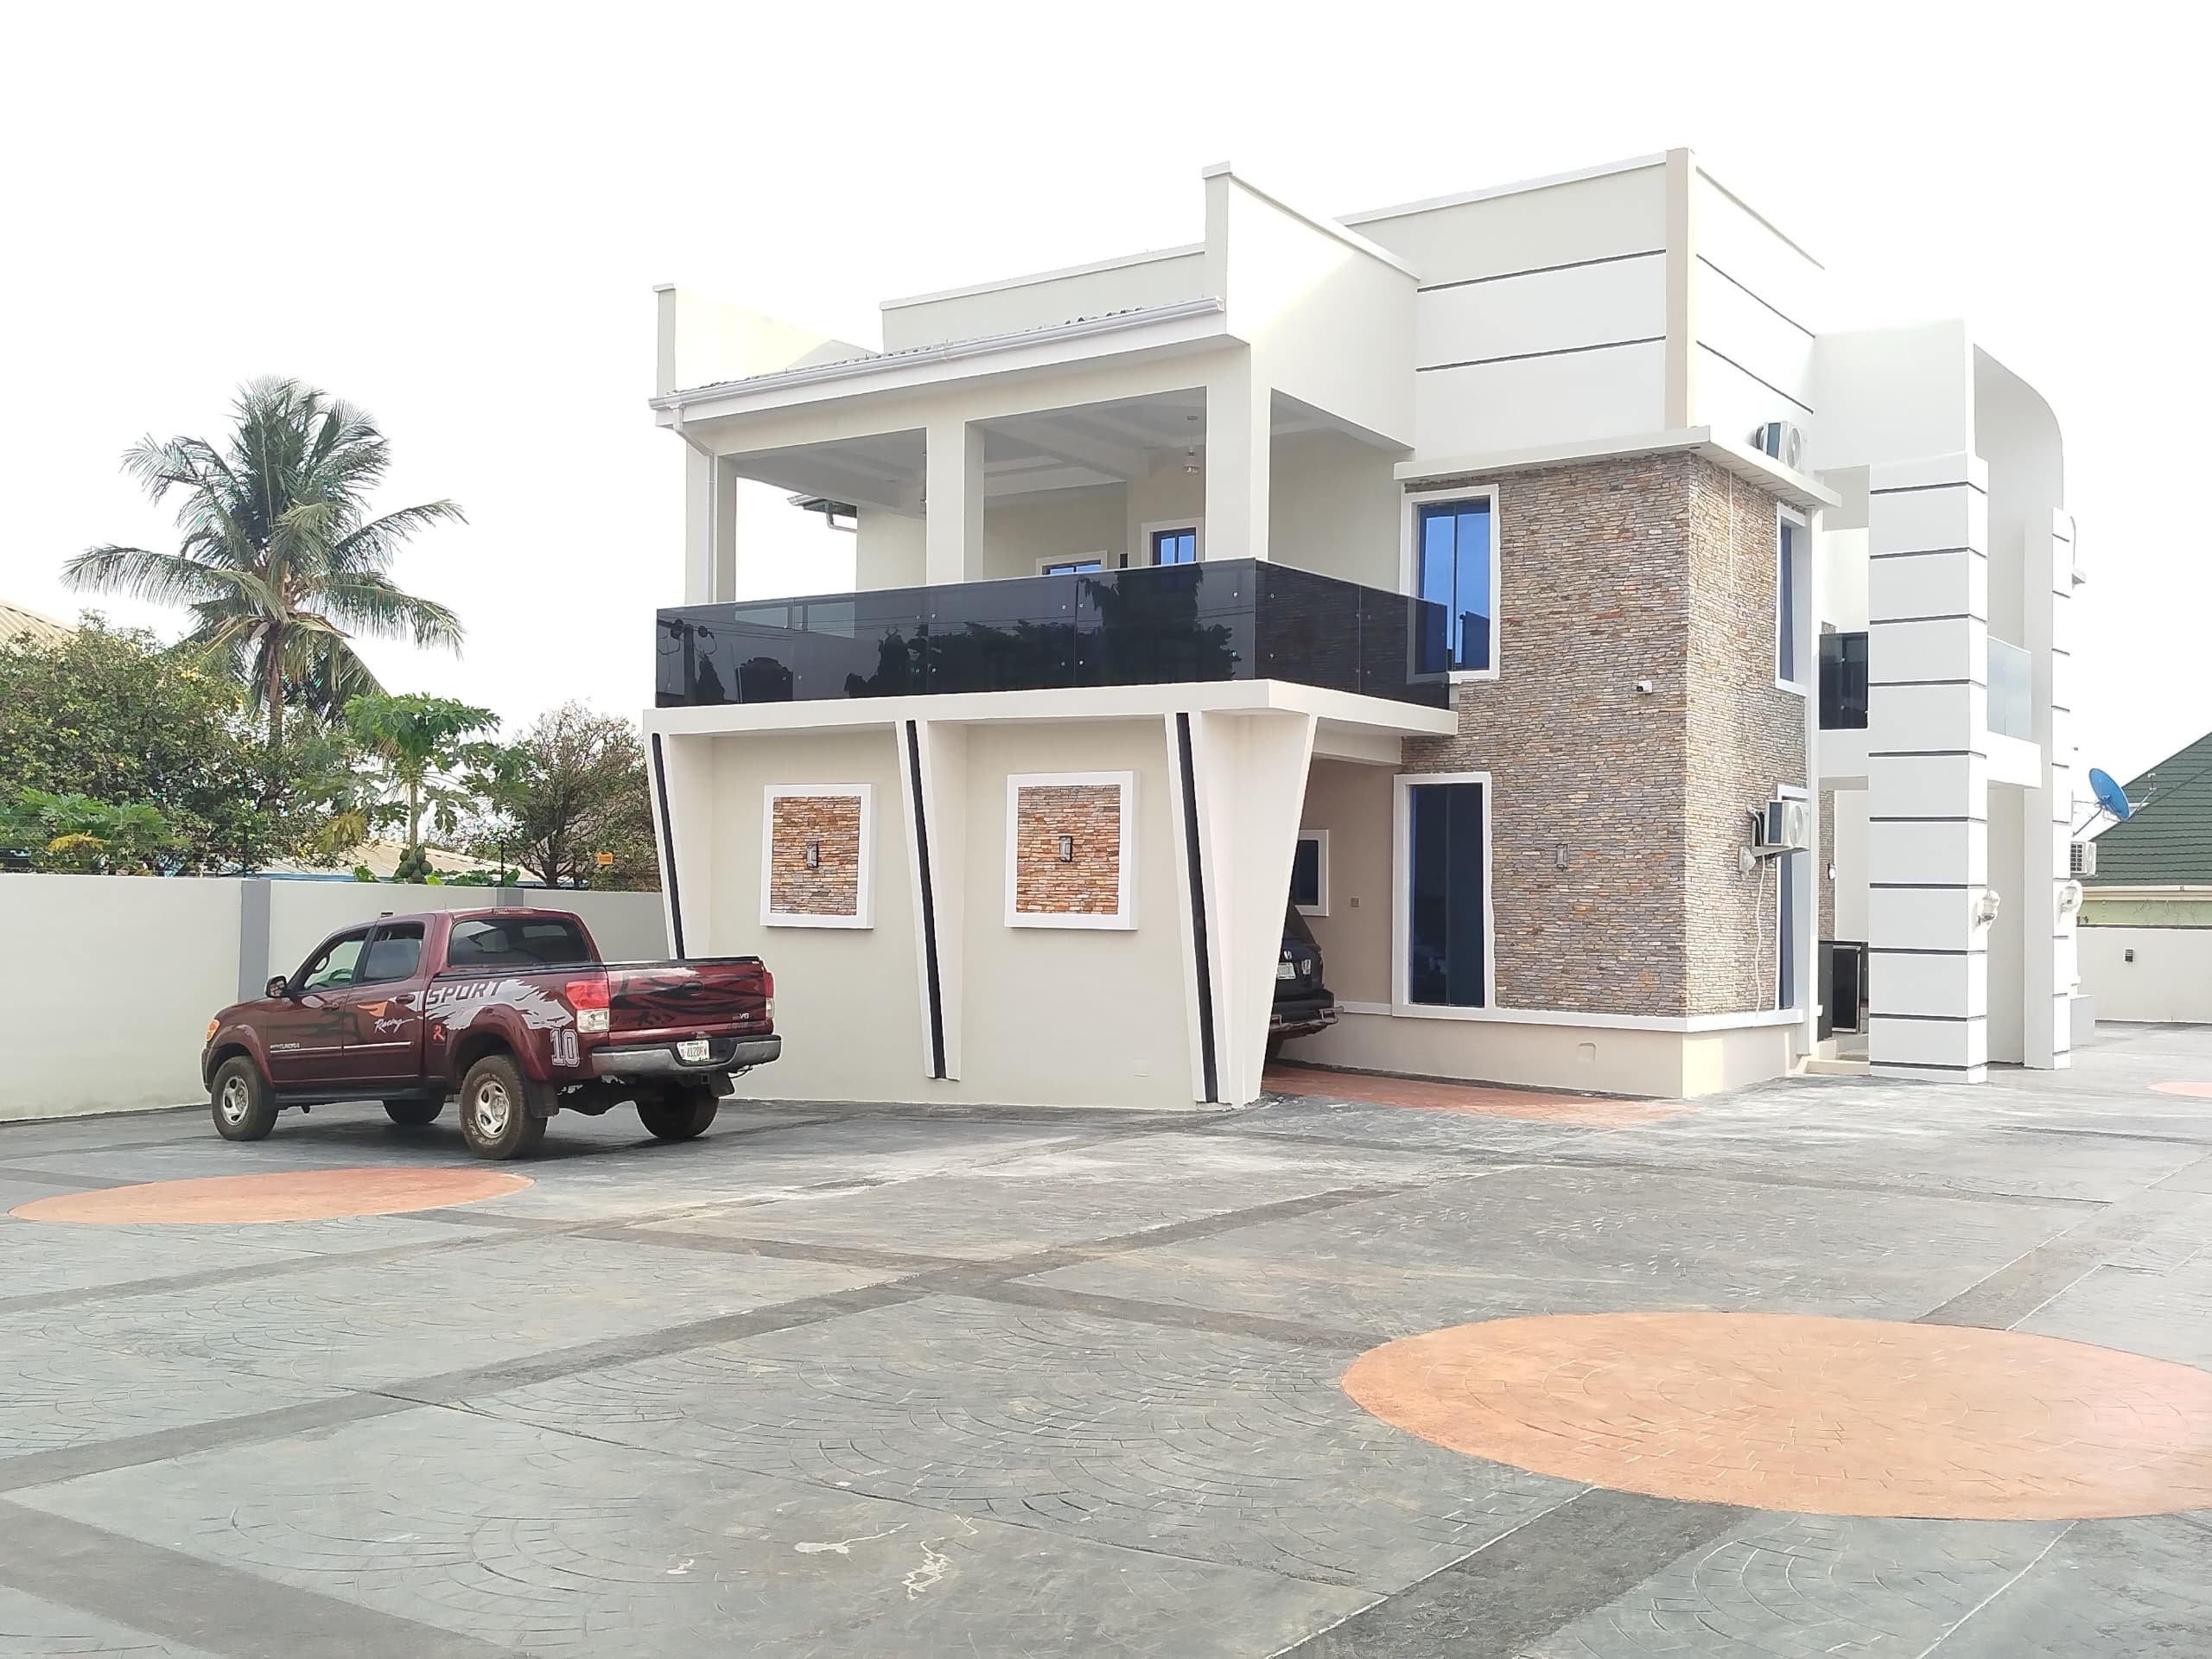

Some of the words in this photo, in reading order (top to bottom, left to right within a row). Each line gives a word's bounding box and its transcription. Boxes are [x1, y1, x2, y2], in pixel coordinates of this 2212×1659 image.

[426, 980, 502, 1005] SPORT
[374, 1018, 415, 1034] Racing
[550, 1027, 580, 1068] 10
